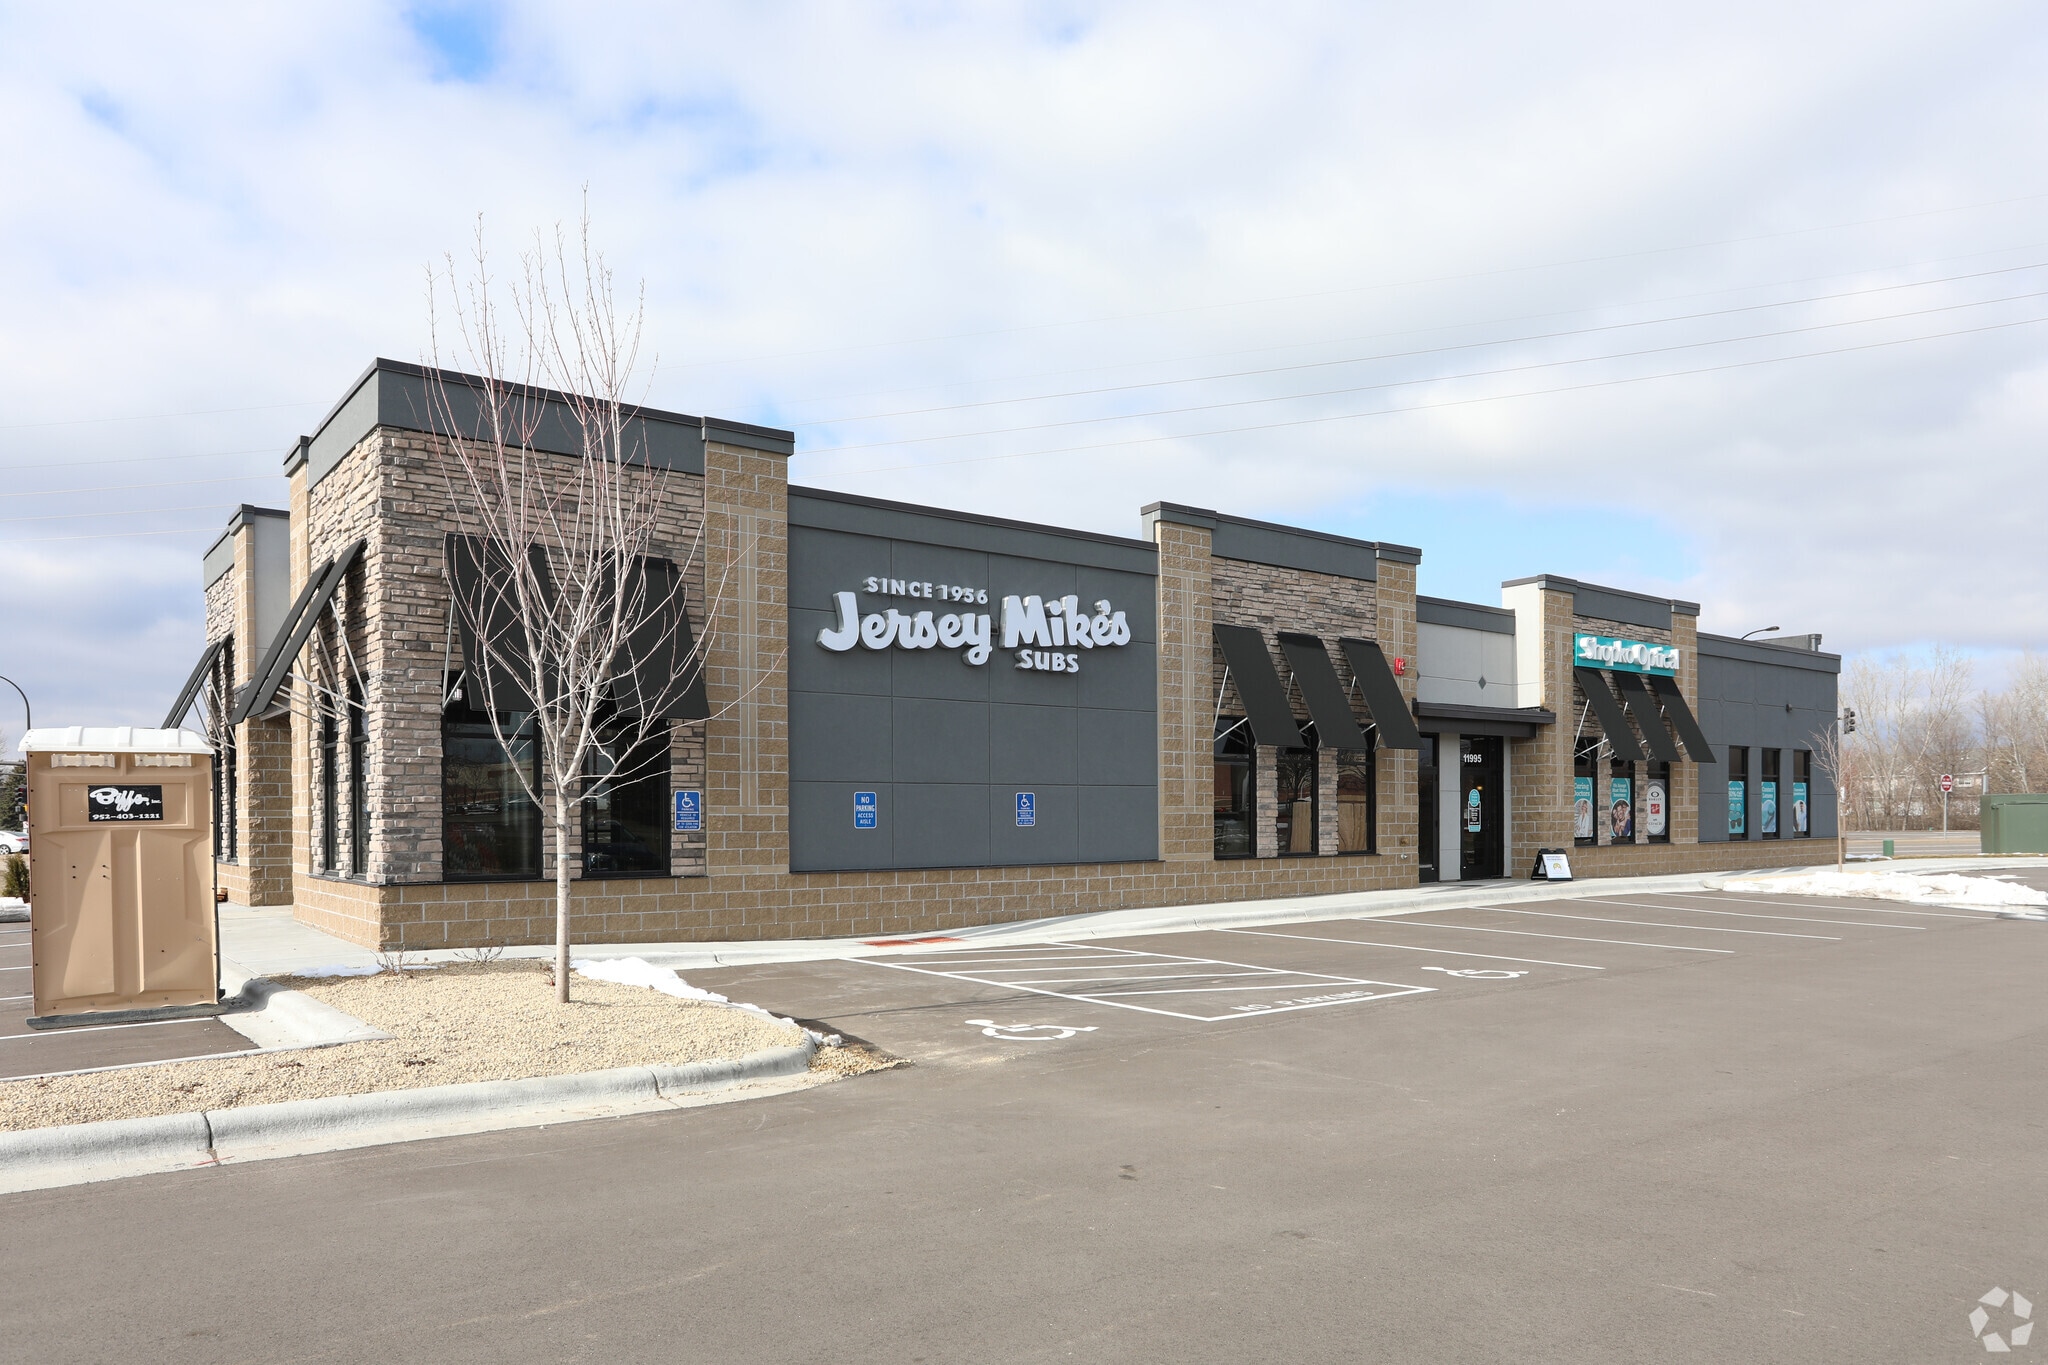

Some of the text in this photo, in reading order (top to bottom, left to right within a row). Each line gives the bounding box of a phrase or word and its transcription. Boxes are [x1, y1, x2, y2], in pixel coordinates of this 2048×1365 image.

[862, 576, 989, 605] SINCE 1956
[816, 591, 1131, 666] Jersey Mike's
[1014, 649, 1080, 673] SUBS
[1577, 636, 1680, 671] Shopko Optical
[1463, 753, 1482, 763] 11995
[860, 796, 870, 804] NO
